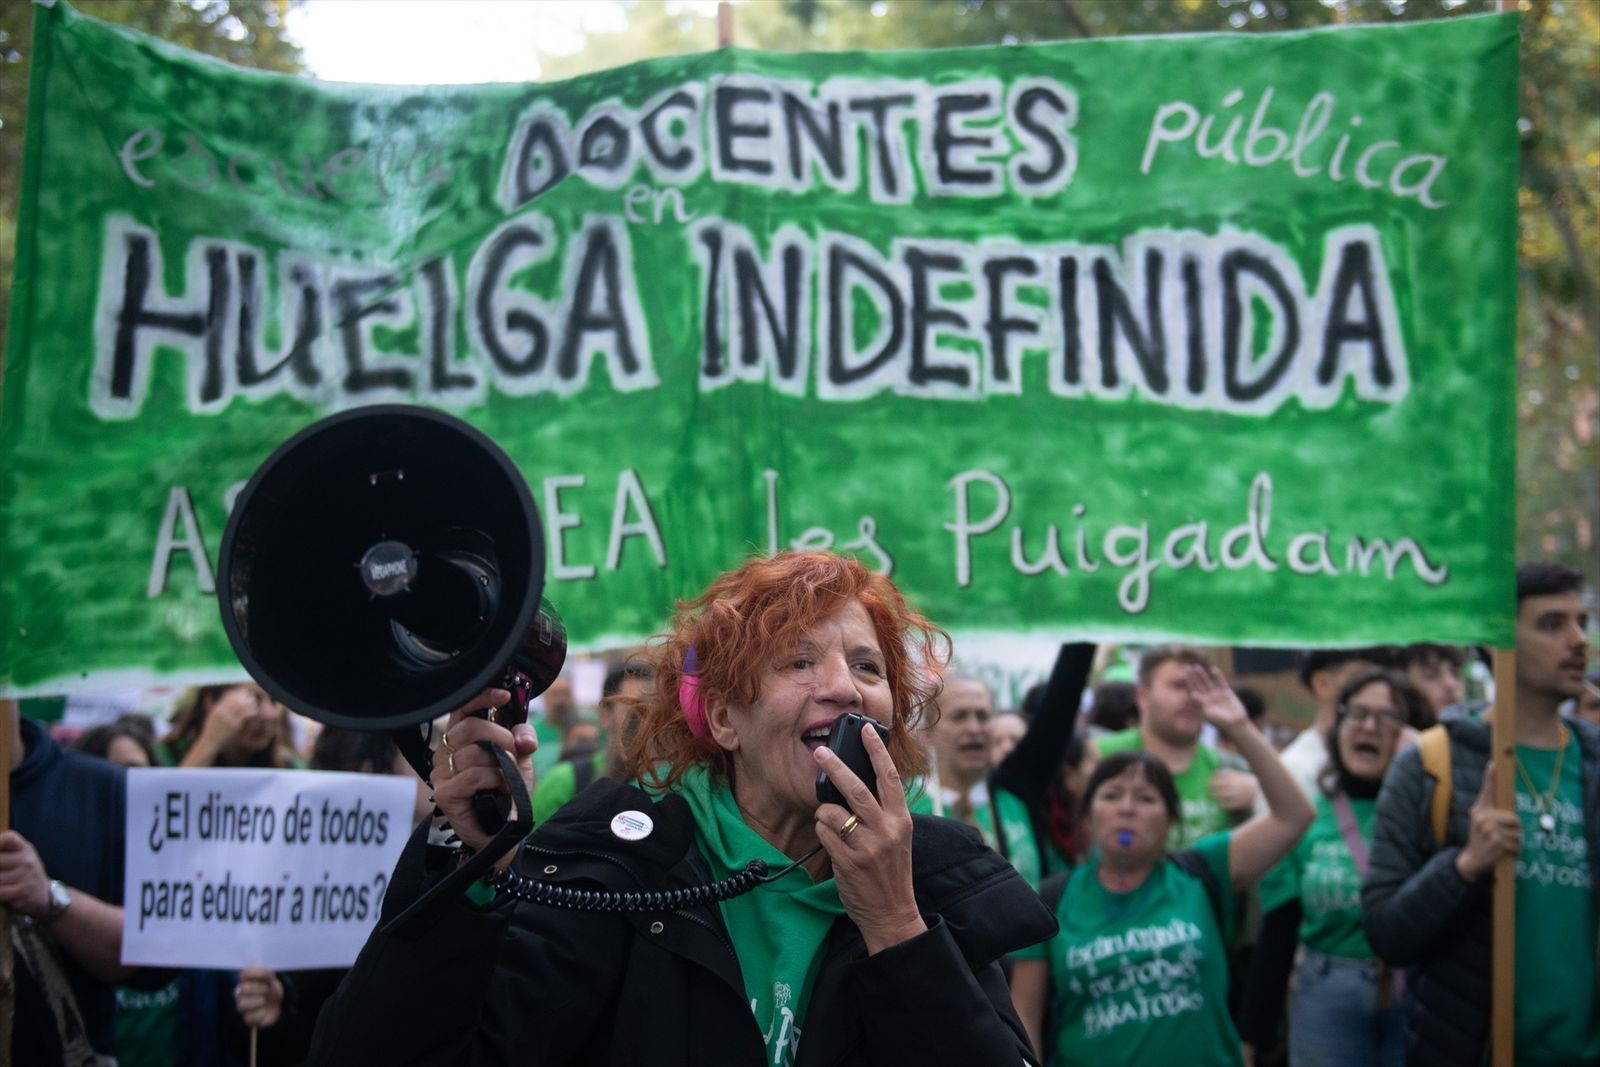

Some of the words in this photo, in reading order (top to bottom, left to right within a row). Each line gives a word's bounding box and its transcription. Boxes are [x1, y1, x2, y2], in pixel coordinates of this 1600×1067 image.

[119, 127, 455, 201] escuela
[499, 76, 1076, 212] DOCENTES
[1139, 86, 1449, 209] pública
[624, 184, 696, 224] en
[92, 214, 658, 419] HUELGA
[695, 226, 1409, 414] INDEFINIDA
[943, 469, 1447, 613] Puigadam
[150, 792, 189, 852] ¿El
[198, 793, 276, 843] dinero
[282, 794, 312, 843] de
[320, 799, 389, 845] todos
[139, 880, 193, 932] para
[201, 870, 285, 925] educar
[290, 882, 304, 922] a
[310, 873, 388, 922] ricos?
